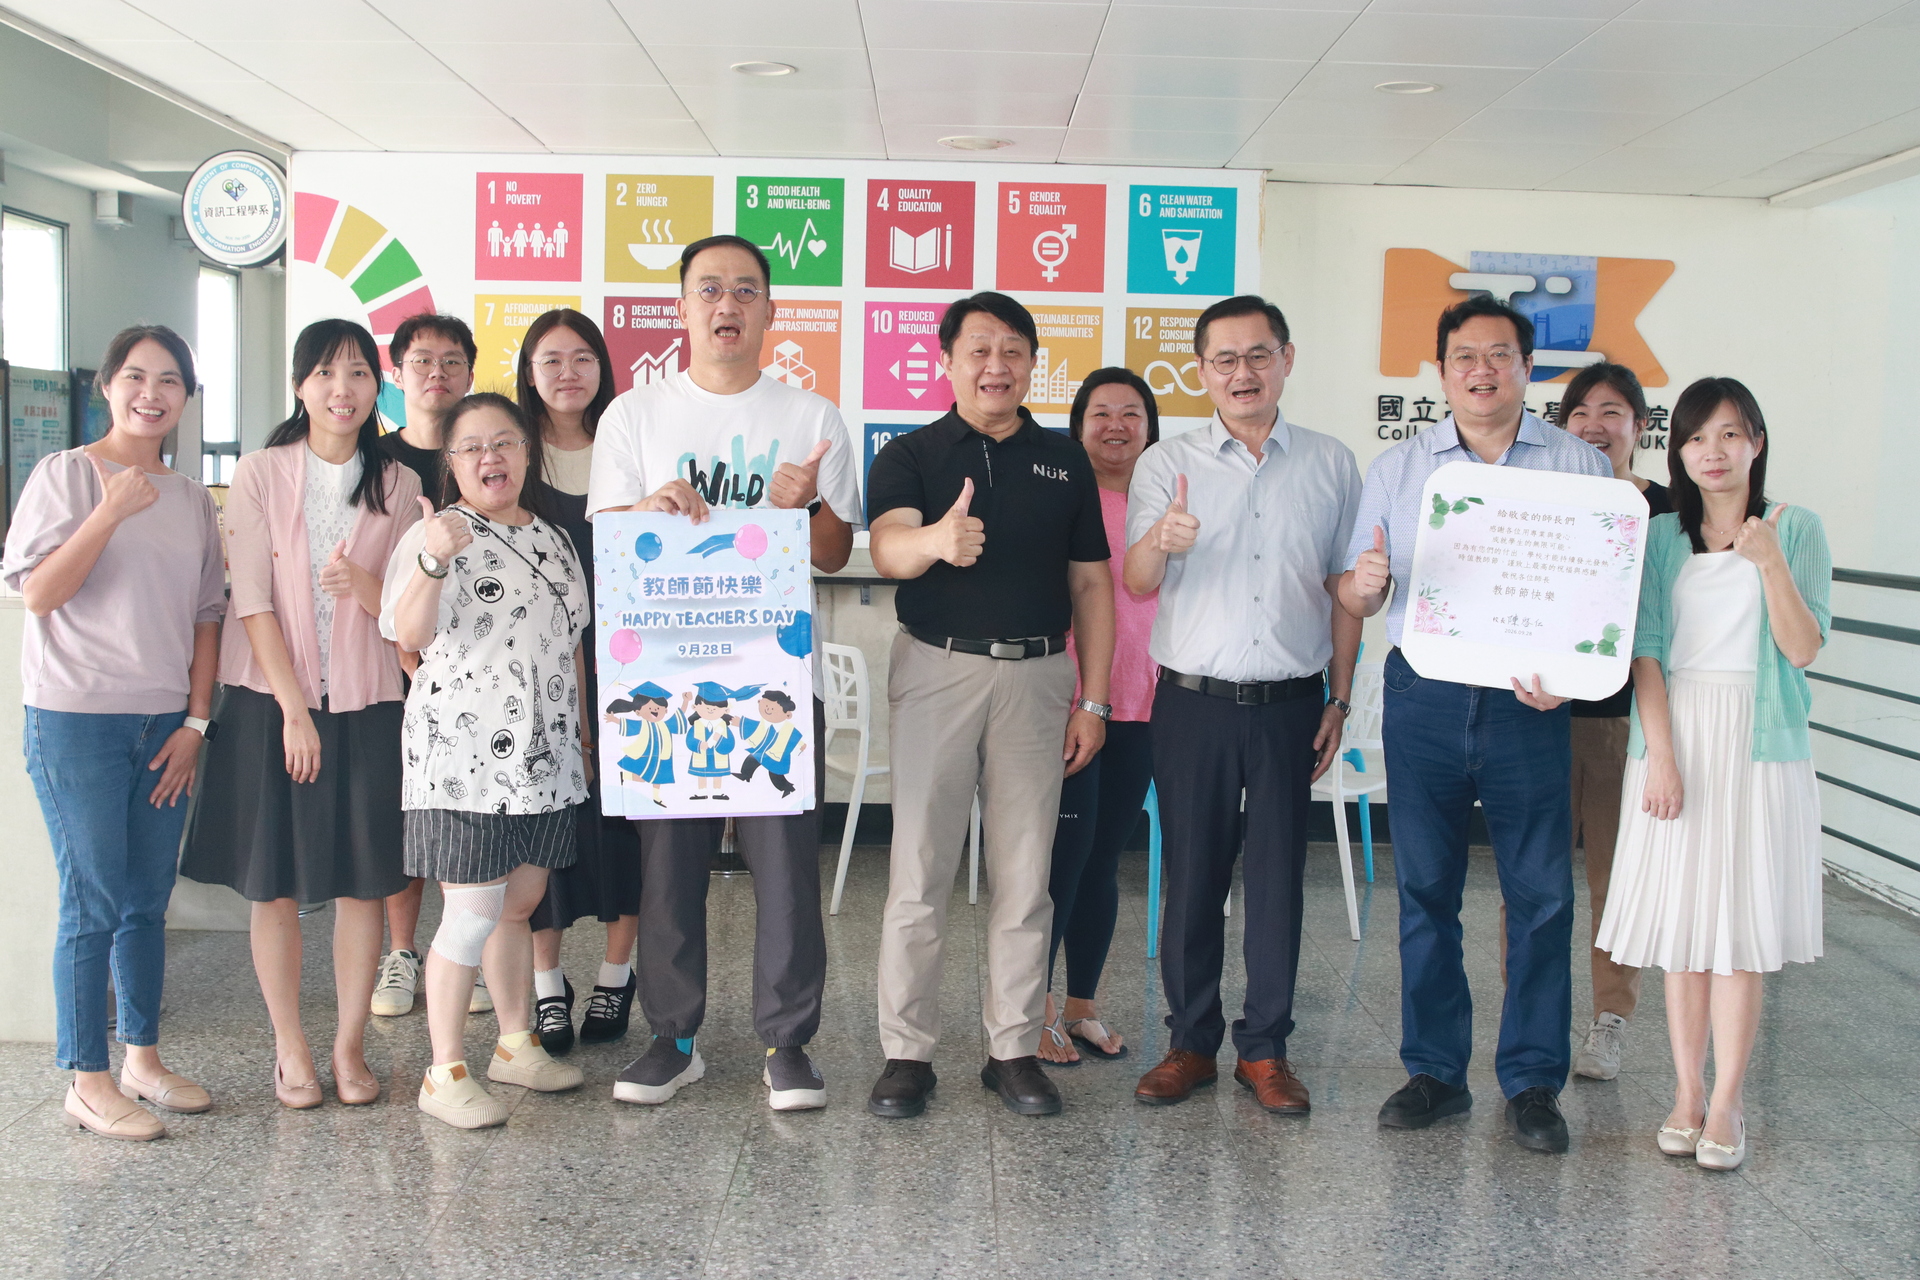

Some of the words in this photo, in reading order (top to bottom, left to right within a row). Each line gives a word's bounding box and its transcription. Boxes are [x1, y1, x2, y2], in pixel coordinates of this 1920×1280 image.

[193, 168, 218, 205] DEPARTMENT
[220, 163, 229, 171] OF
[231, 162, 265, 177] COMPUTER
[264, 177, 279, 202] SCIENCE
[505, 181, 518, 192] NO
[636, 183, 657, 194] ZERO
[487, 180, 496, 204] 1
[615, 182, 628, 206] 2
[746, 184, 759, 208] 3
[767, 185, 790, 196] GOOD
[790, 186, 820, 197] HEALTH
[898, 188, 932, 200] QUALITY
[1029, 191, 1061, 203] GENDER
[505, 194, 542, 205] POVERTY
[636, 196, 668, 207] HUNGER
[767, 198, 785, 209] AND
[785, 199, 831, 210] WELL-BEING
[876, 187, 890, 212] 4
[1008, 190, 1020, 214] 5
[1139, 193, 1151, 217] 6
[1159, 194, 1184, 205] CLEAN
[1185, 195, 1213, 206] WATER
[204, 204, 269, 218] 資訊工程學系
[898, 201, 942, 213] EDUCATION
[1029, 203, 1067, 216] EQUALITY
[1159, 206, 1177, 218] AND
[1177, 207, 1223, 219] SANITATION
[195, 221, 206, 235] AND
[205, 234, 246, 252] INFORMATION
[248, 217, 279, 250] ENGINEERING
[484, 302, 495, 326] 7
[612, 304, 625, 328] 8
[631, 305, 662, 316] DECENT
[662, 305, 678, 316] WO
[774, 307, 796, 319] STRY,
[796, 308, 839, 320] INNOVATION
[898, 310, 935, 322] REDUCED
[504, 315, 529, 327] CLEAN
[631, 317, 672, 329] ECONOMIC
[871, 309, 893, 334] 10
[1076, 314, 1100, 326] CITIES
[1159, 316, 1199, 328] RESPONSI
[775, 321, 838, 333] INFRASTRUCTURE
[1041, 326, 1094, 338] COMMUNITIES
[1133, 315, 1153, 340] 12
[1159, 342, 1176, 353] AND
[688, 458, 765, 507] WILD
[1497, 509, 1576, 526] 給敬愛的師長們
[642, 575, 763, 597] 教師節快樂
[1492, 584, 1555, 602] 教師節快樂
[622, 611, 671, 628] HAPPY
[675, 609, 759, 626] TEACHER'S
[762, 609, 794, 625] DAY
[678, 643, 732, 656] 9月28日
